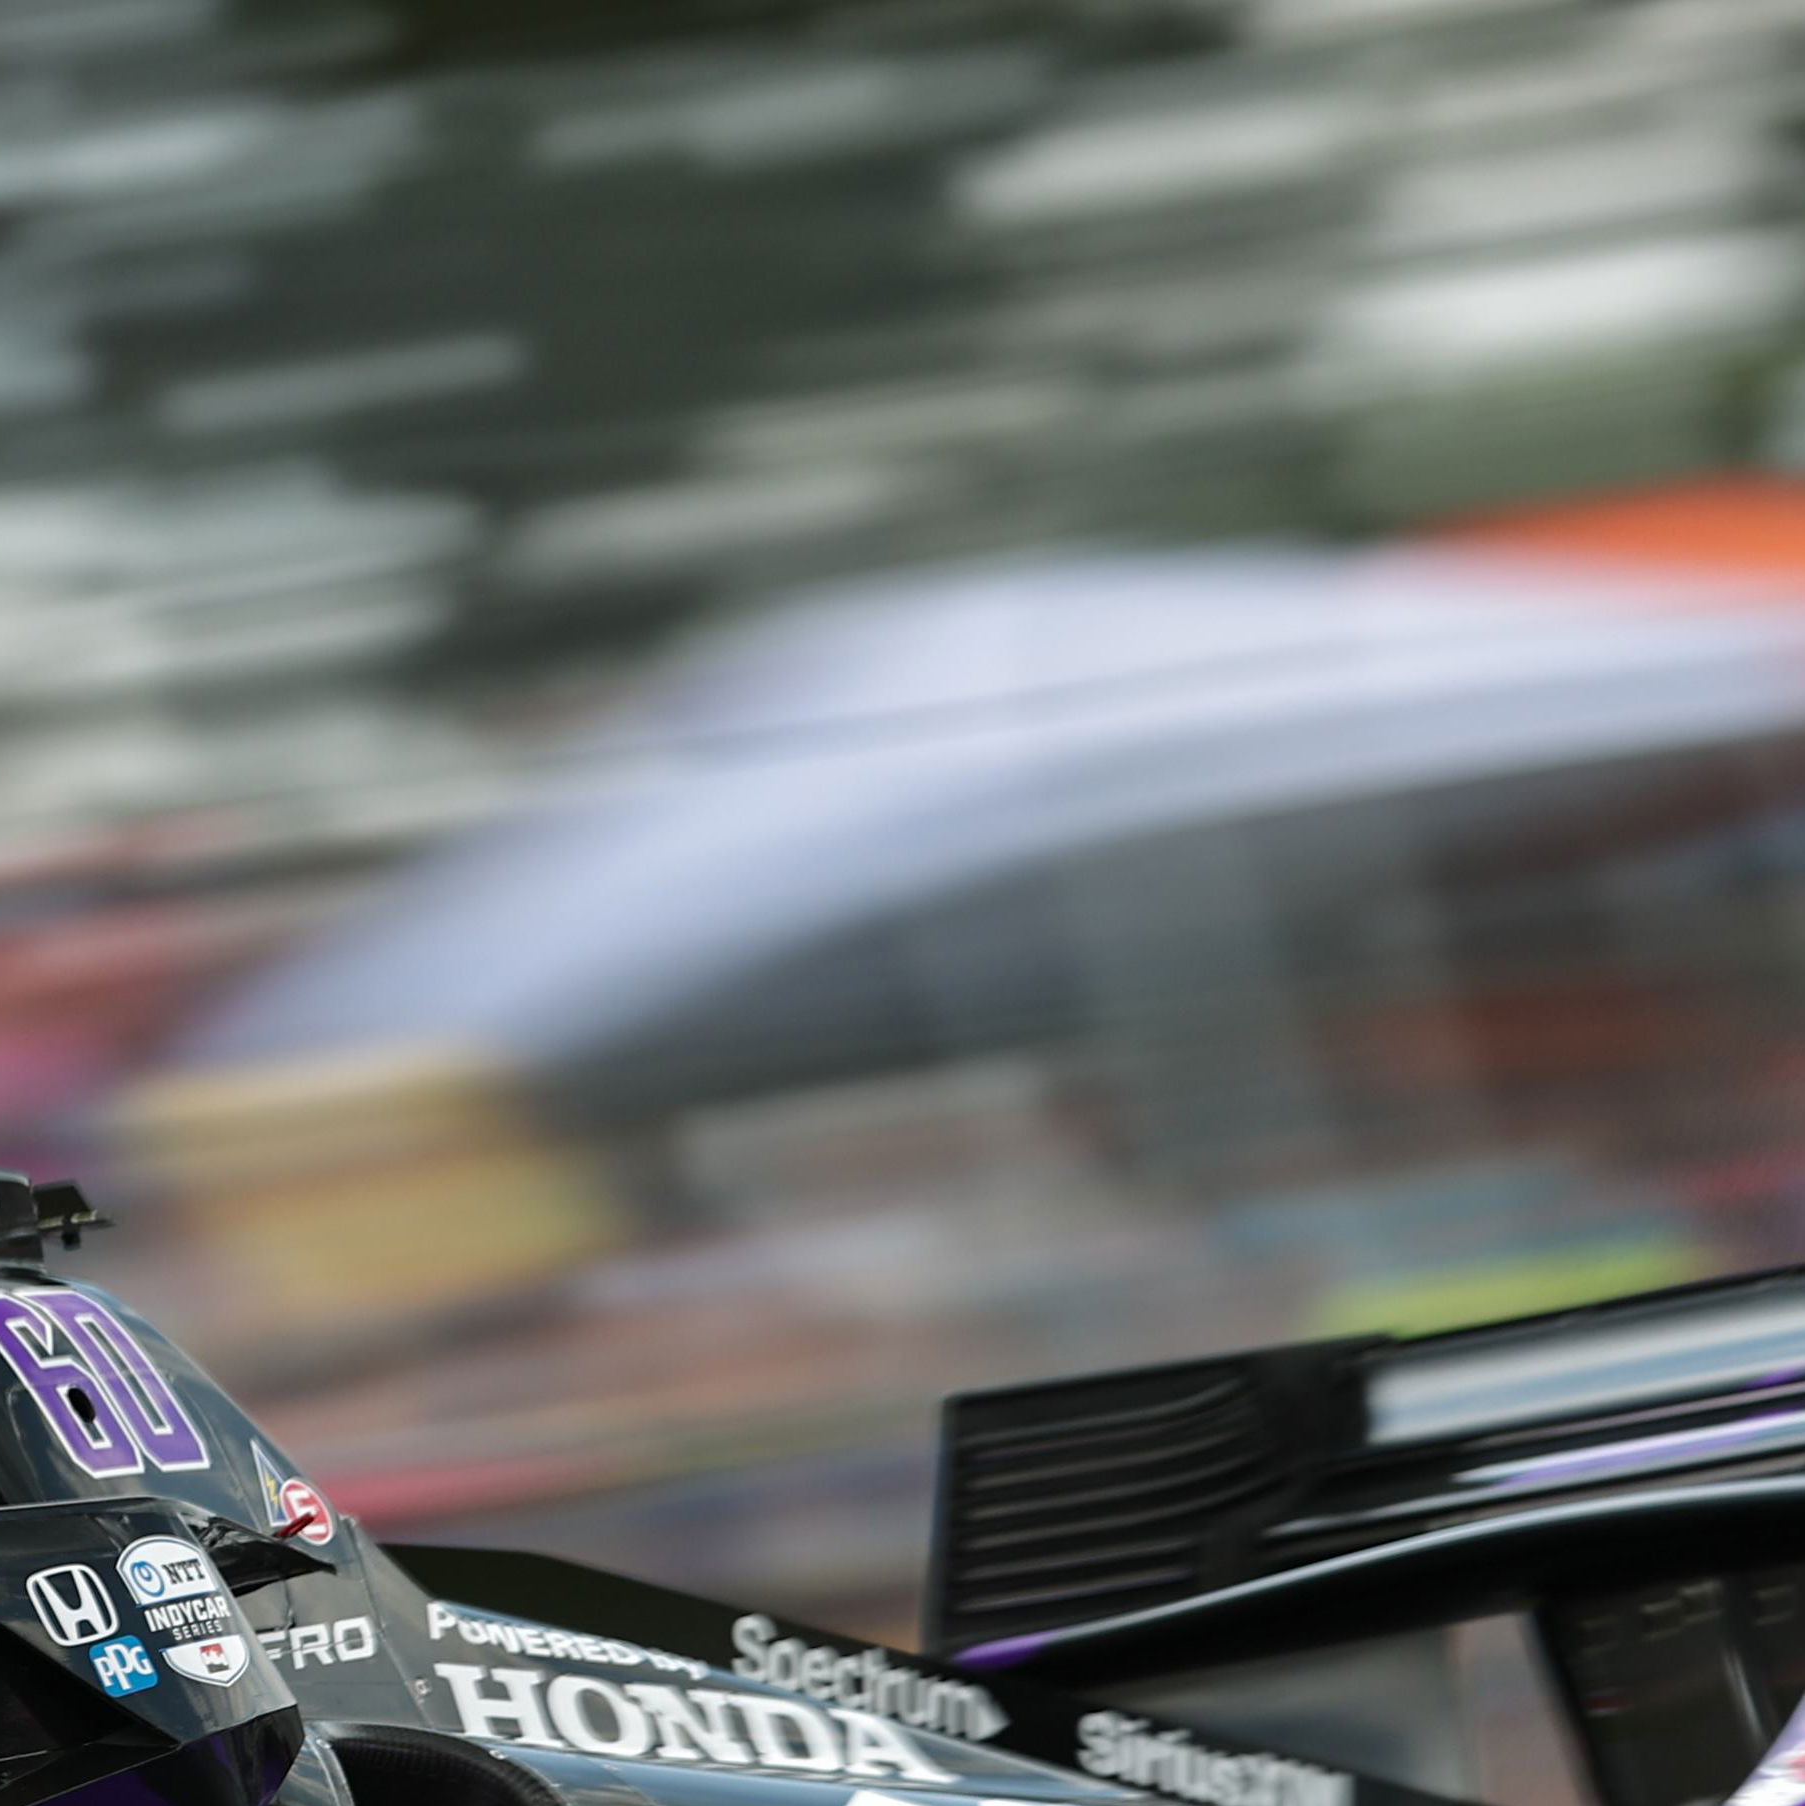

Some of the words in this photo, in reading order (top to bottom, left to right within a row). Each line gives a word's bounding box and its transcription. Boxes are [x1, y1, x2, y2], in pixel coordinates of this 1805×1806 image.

[161, 1558, 206, 1585] NTT
[144, 1596, 231, 1633] INDYCAR
[171, 1621, 223, 1641] SERIES
[93, 1643, 155, 1690] PPG
[434, 1663, 960, 1784] HONDA
